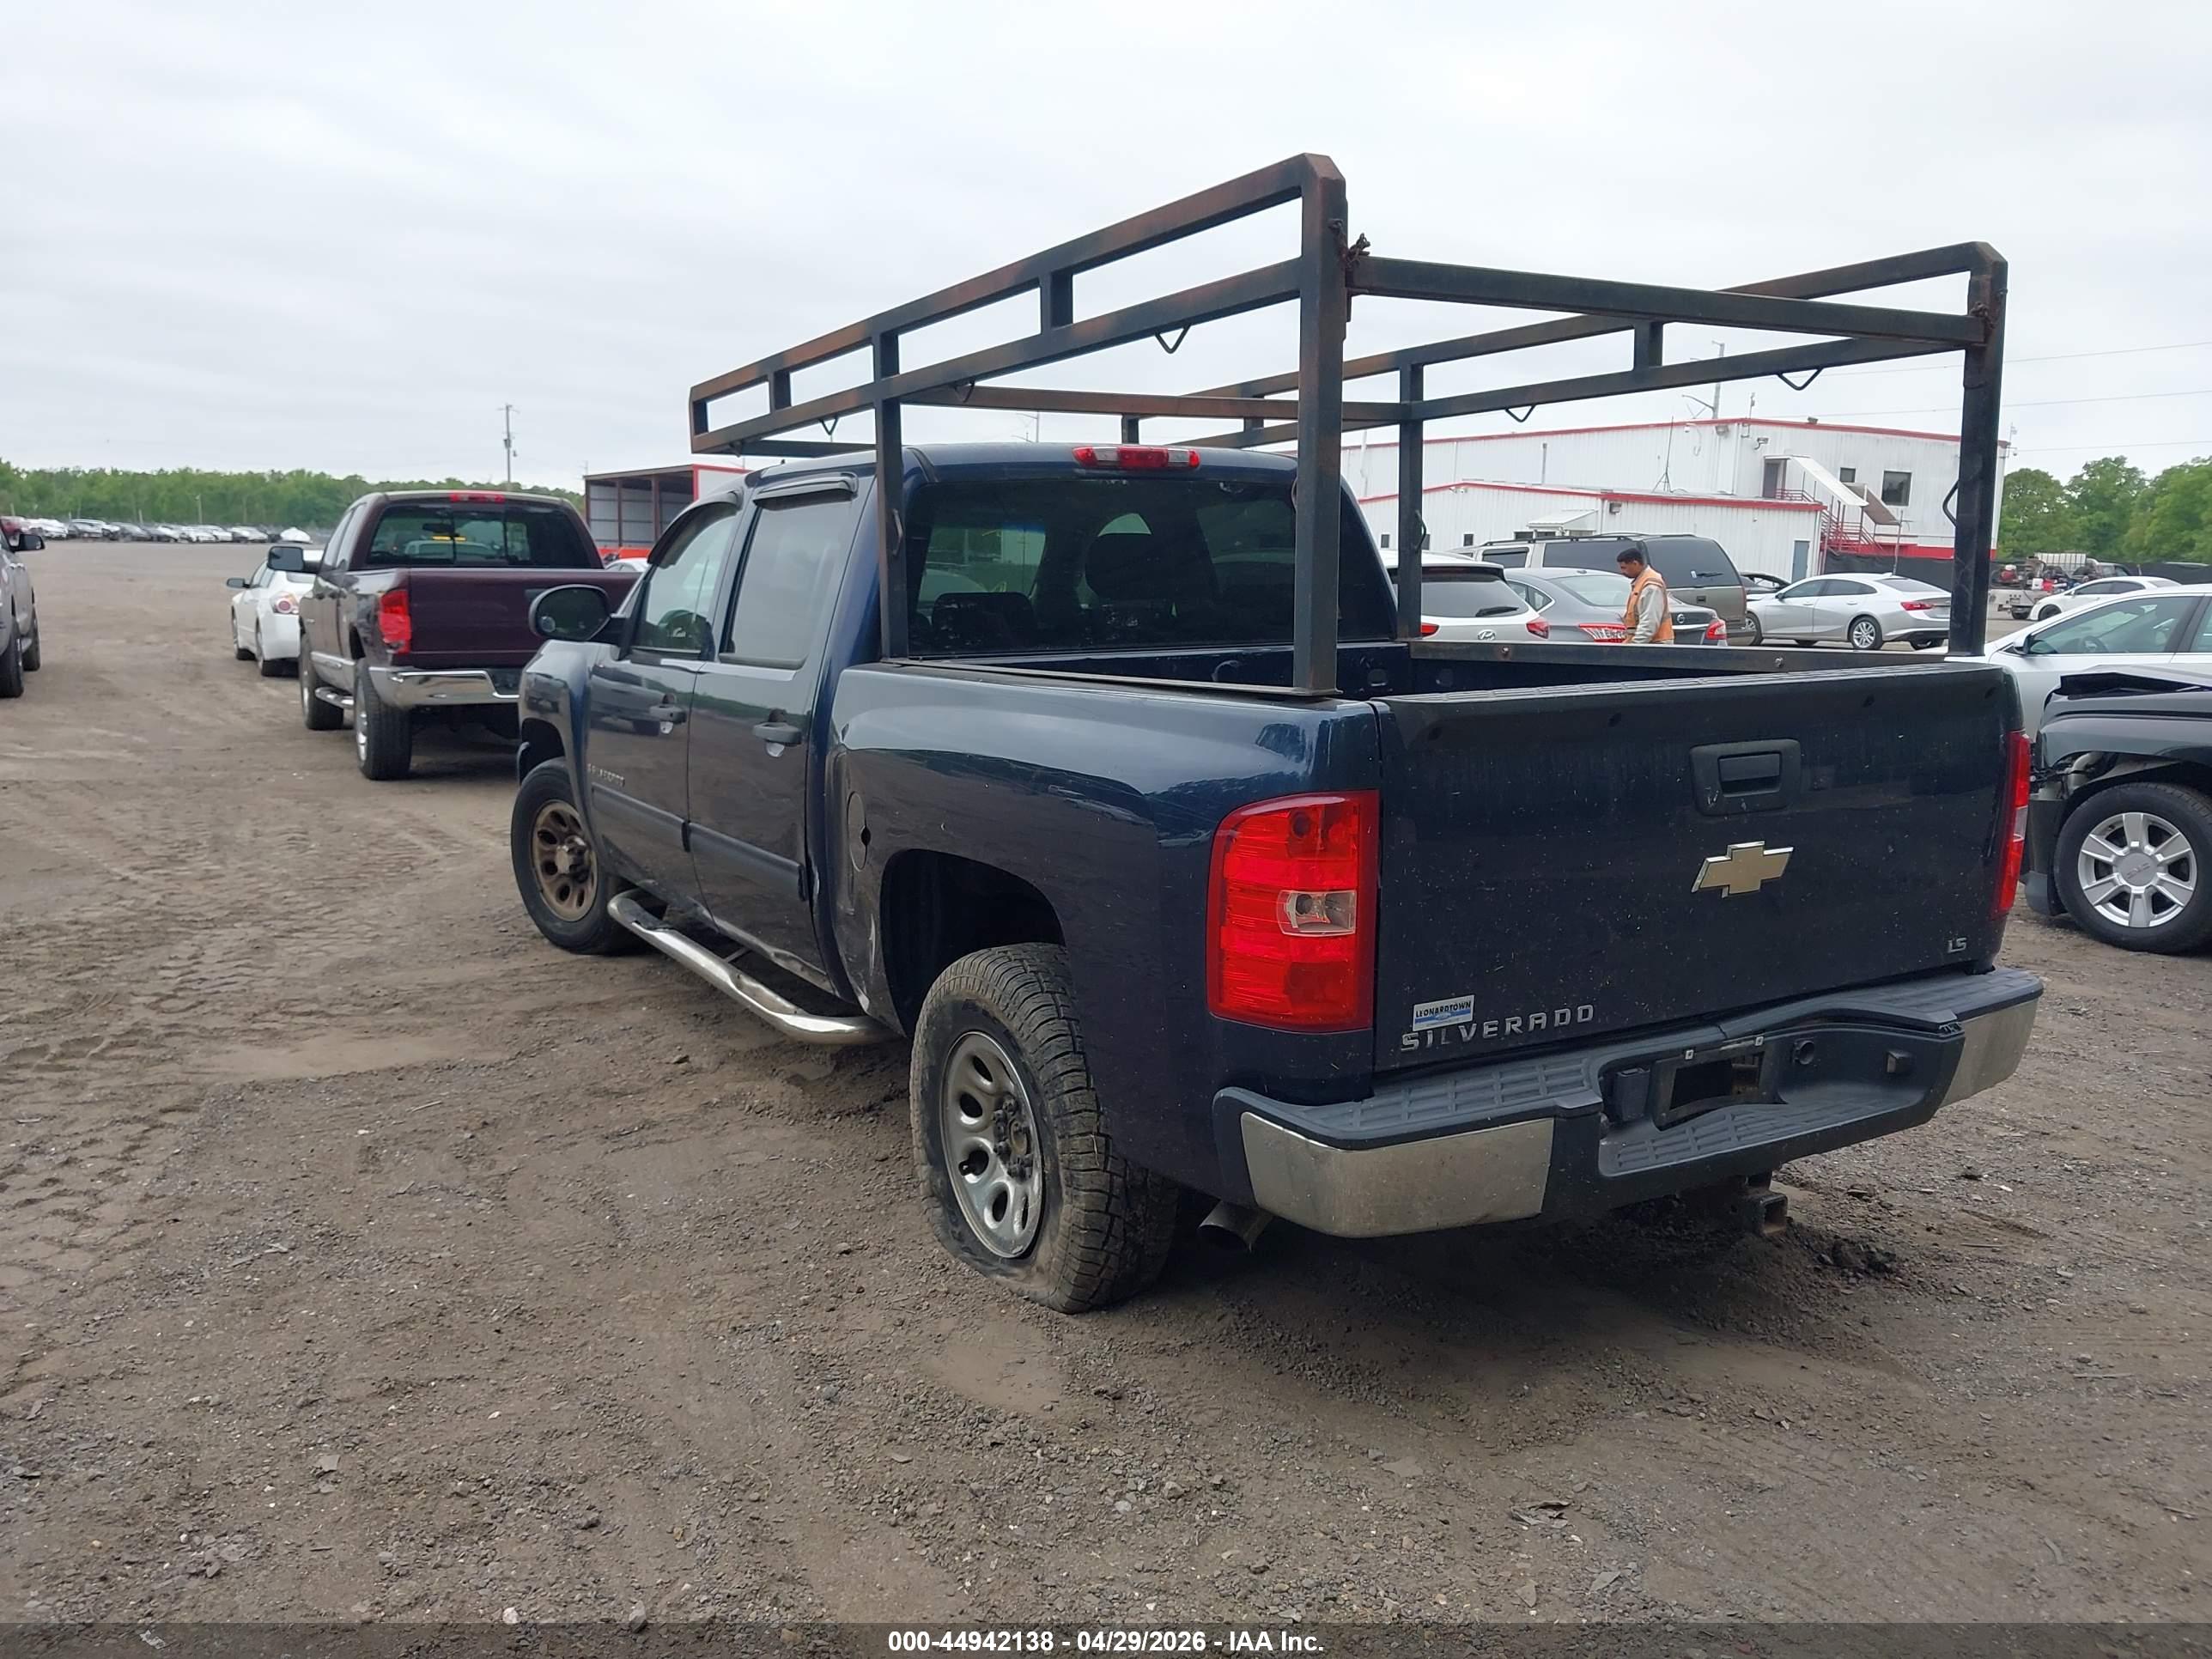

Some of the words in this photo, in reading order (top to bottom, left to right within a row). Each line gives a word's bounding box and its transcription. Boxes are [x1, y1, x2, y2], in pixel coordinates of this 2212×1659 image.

[1948, 937, 1967, 953] LS
[1415, 1000, 1472, 1018] LEONARDTOWN
[1401, 1004, 1595, 1052] SILVERADO
